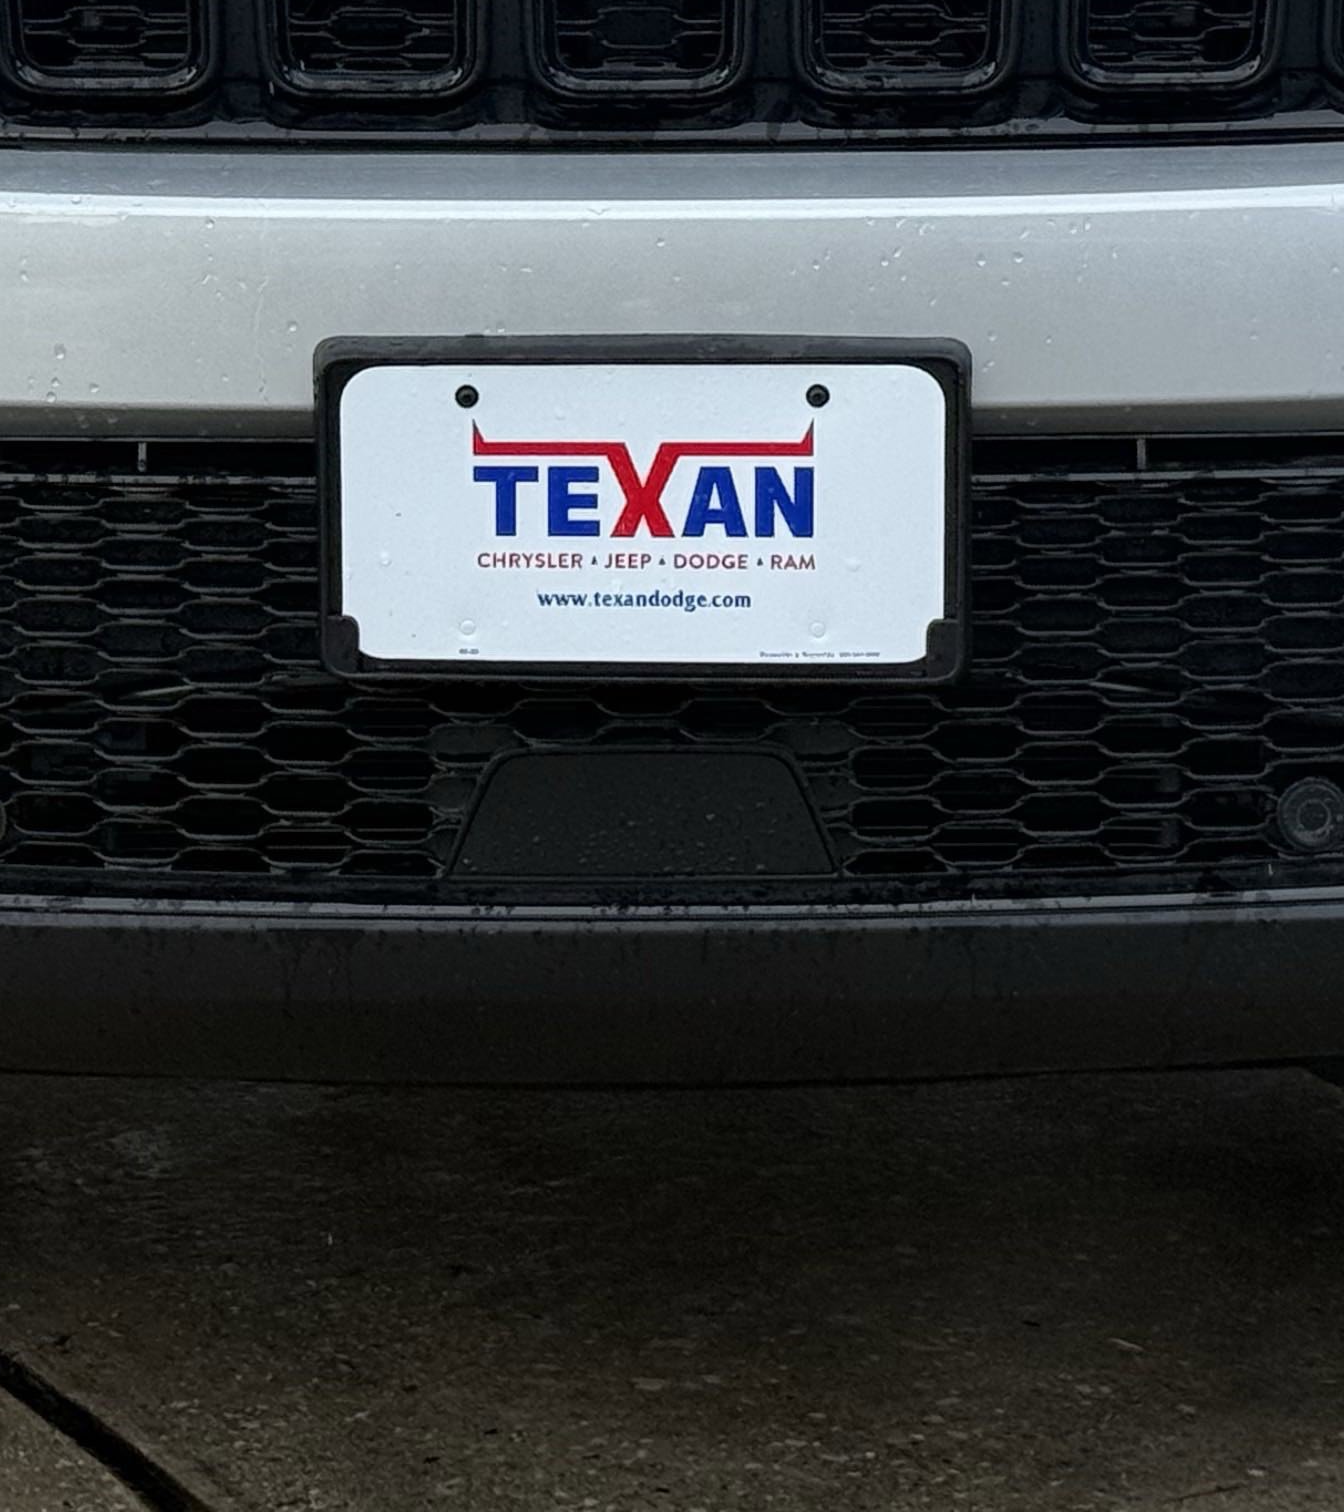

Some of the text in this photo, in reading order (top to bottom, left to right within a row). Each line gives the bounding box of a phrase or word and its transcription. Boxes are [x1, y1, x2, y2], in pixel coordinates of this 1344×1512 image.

[472, 443, 815, 539] TEXAN
[476, 551, 817, 571] CHRYSLER JEEP DODGE RAM
[536, 588, 753, 614] www.texandodge.com
